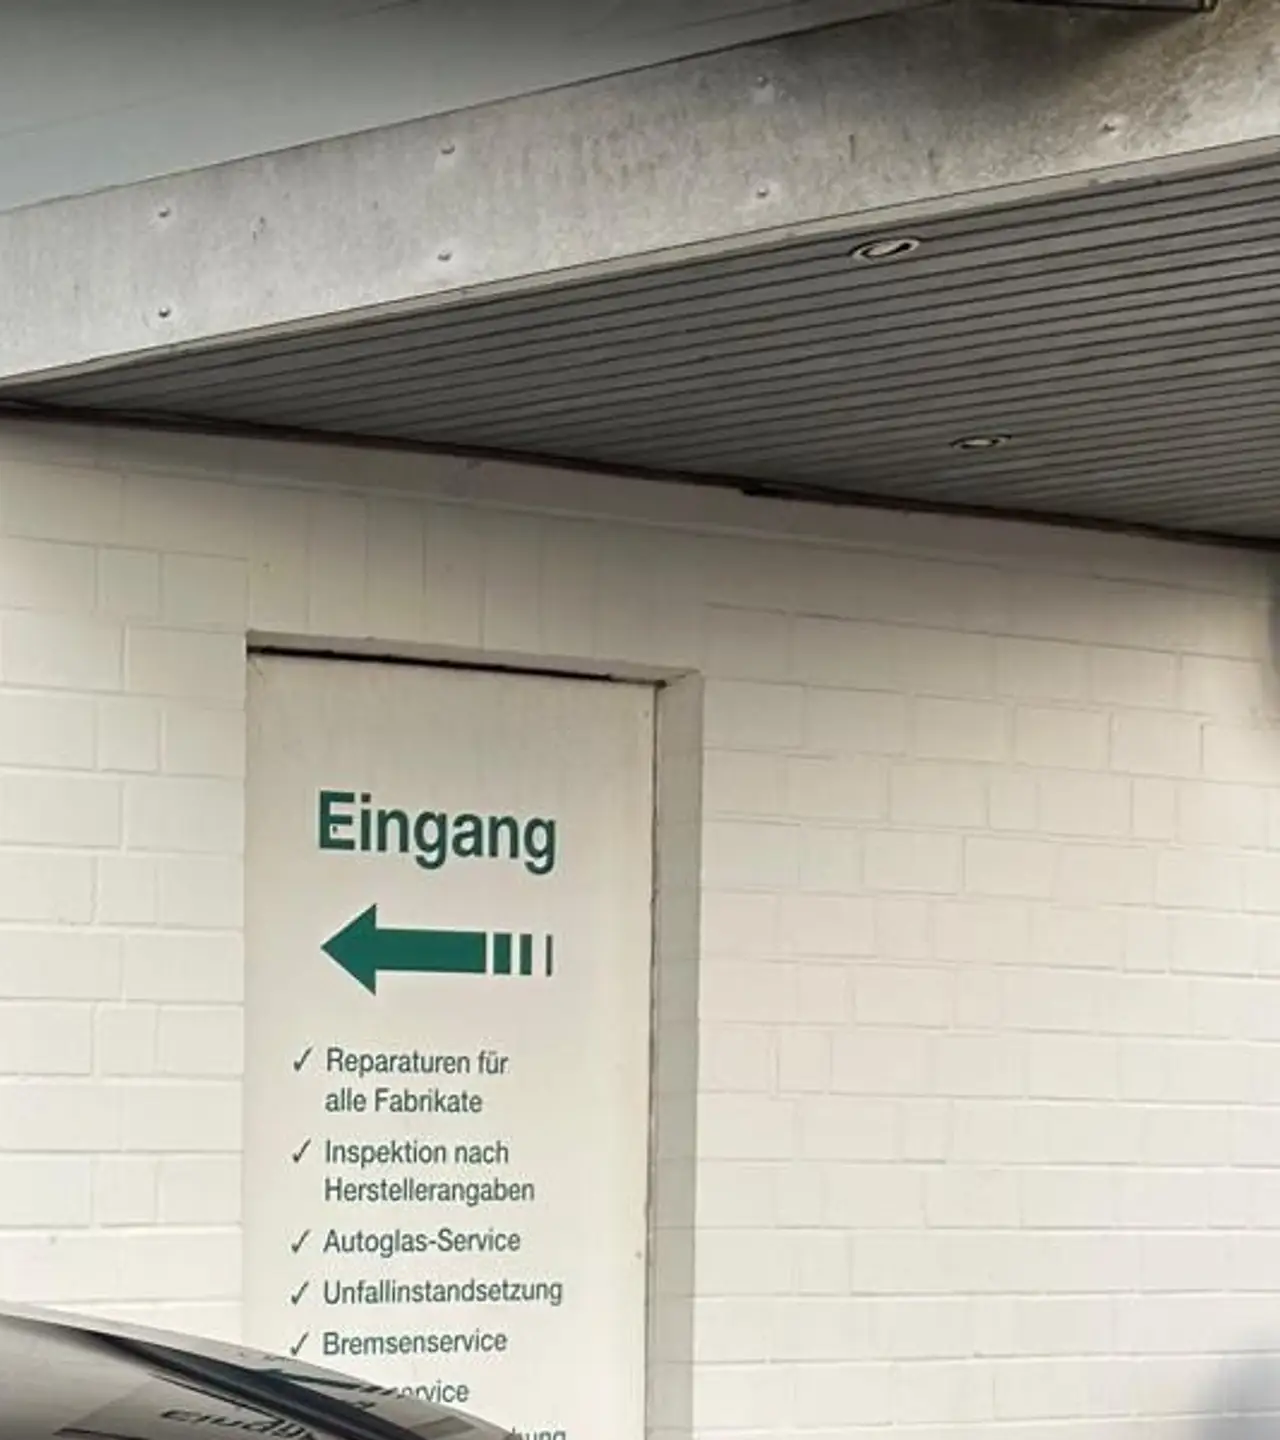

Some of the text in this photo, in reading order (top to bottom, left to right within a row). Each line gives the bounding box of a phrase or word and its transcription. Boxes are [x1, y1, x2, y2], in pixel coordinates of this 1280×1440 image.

[318, 790, 557, 875] Eingang
[326, 1048, 509, 1078] Reparaturen für
[325, 1088, 483, 1114] alle Fabrikate
[325, 1140, 509, 1169] Inspektion nach
[324, 1177, 535, 1207] Herstellerangaben
[322, 1228, 521, 1259] Autoglas-Service
[323, 1279, 563, 1307] Unfallinstandsetzung
[323, 1327, 507, 1356] Bremsenservice
